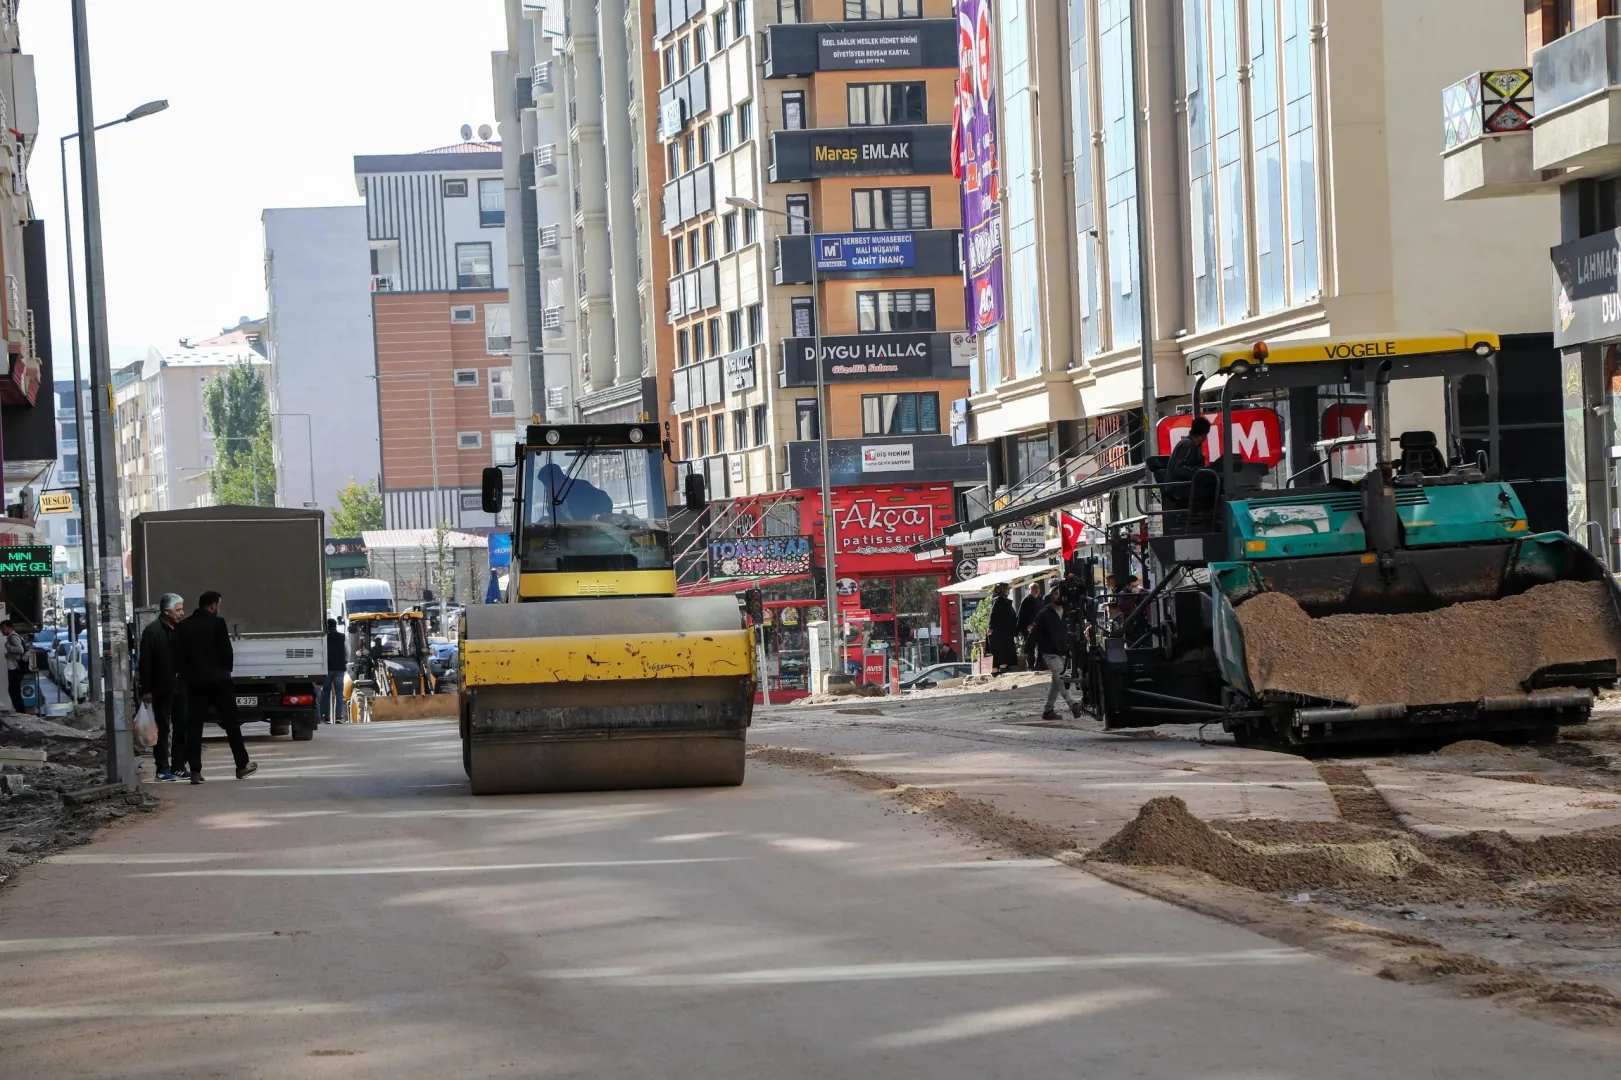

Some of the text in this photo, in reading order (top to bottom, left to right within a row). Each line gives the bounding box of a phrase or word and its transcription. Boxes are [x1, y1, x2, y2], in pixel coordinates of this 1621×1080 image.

[822, 35, 918, 47] ÖZEL SAĞLIK MESLEK HİZMET BİRİMİ
[833, 49, 865, 58] DİYETİSYEN
[888, 48, 910, 56] KARTAL
[815, 142, 909, 164] Maraş EMLAK
[842, 236, 871, 246] SERBEST
[871, 234, 912, 244] MUHASEBECİ
[855, 245, 900, 255] MALİ MÜŞAVİR
[851, 255, 876, 265] CAHİT
[879, 254, 905, 266] İNANÇ
[804, 342, 927, 361] DUYGU HALLAÇ
[1324, 342, 1396, 359] VÖGELE
[41, 496, 71, 506] MESCİD
[841, 503, 925, 533] Akça
[843, 533, 925, 547] patisserie
[709, 540, 769, 560] TOAST
[29, 562, 49, 572] GEL
